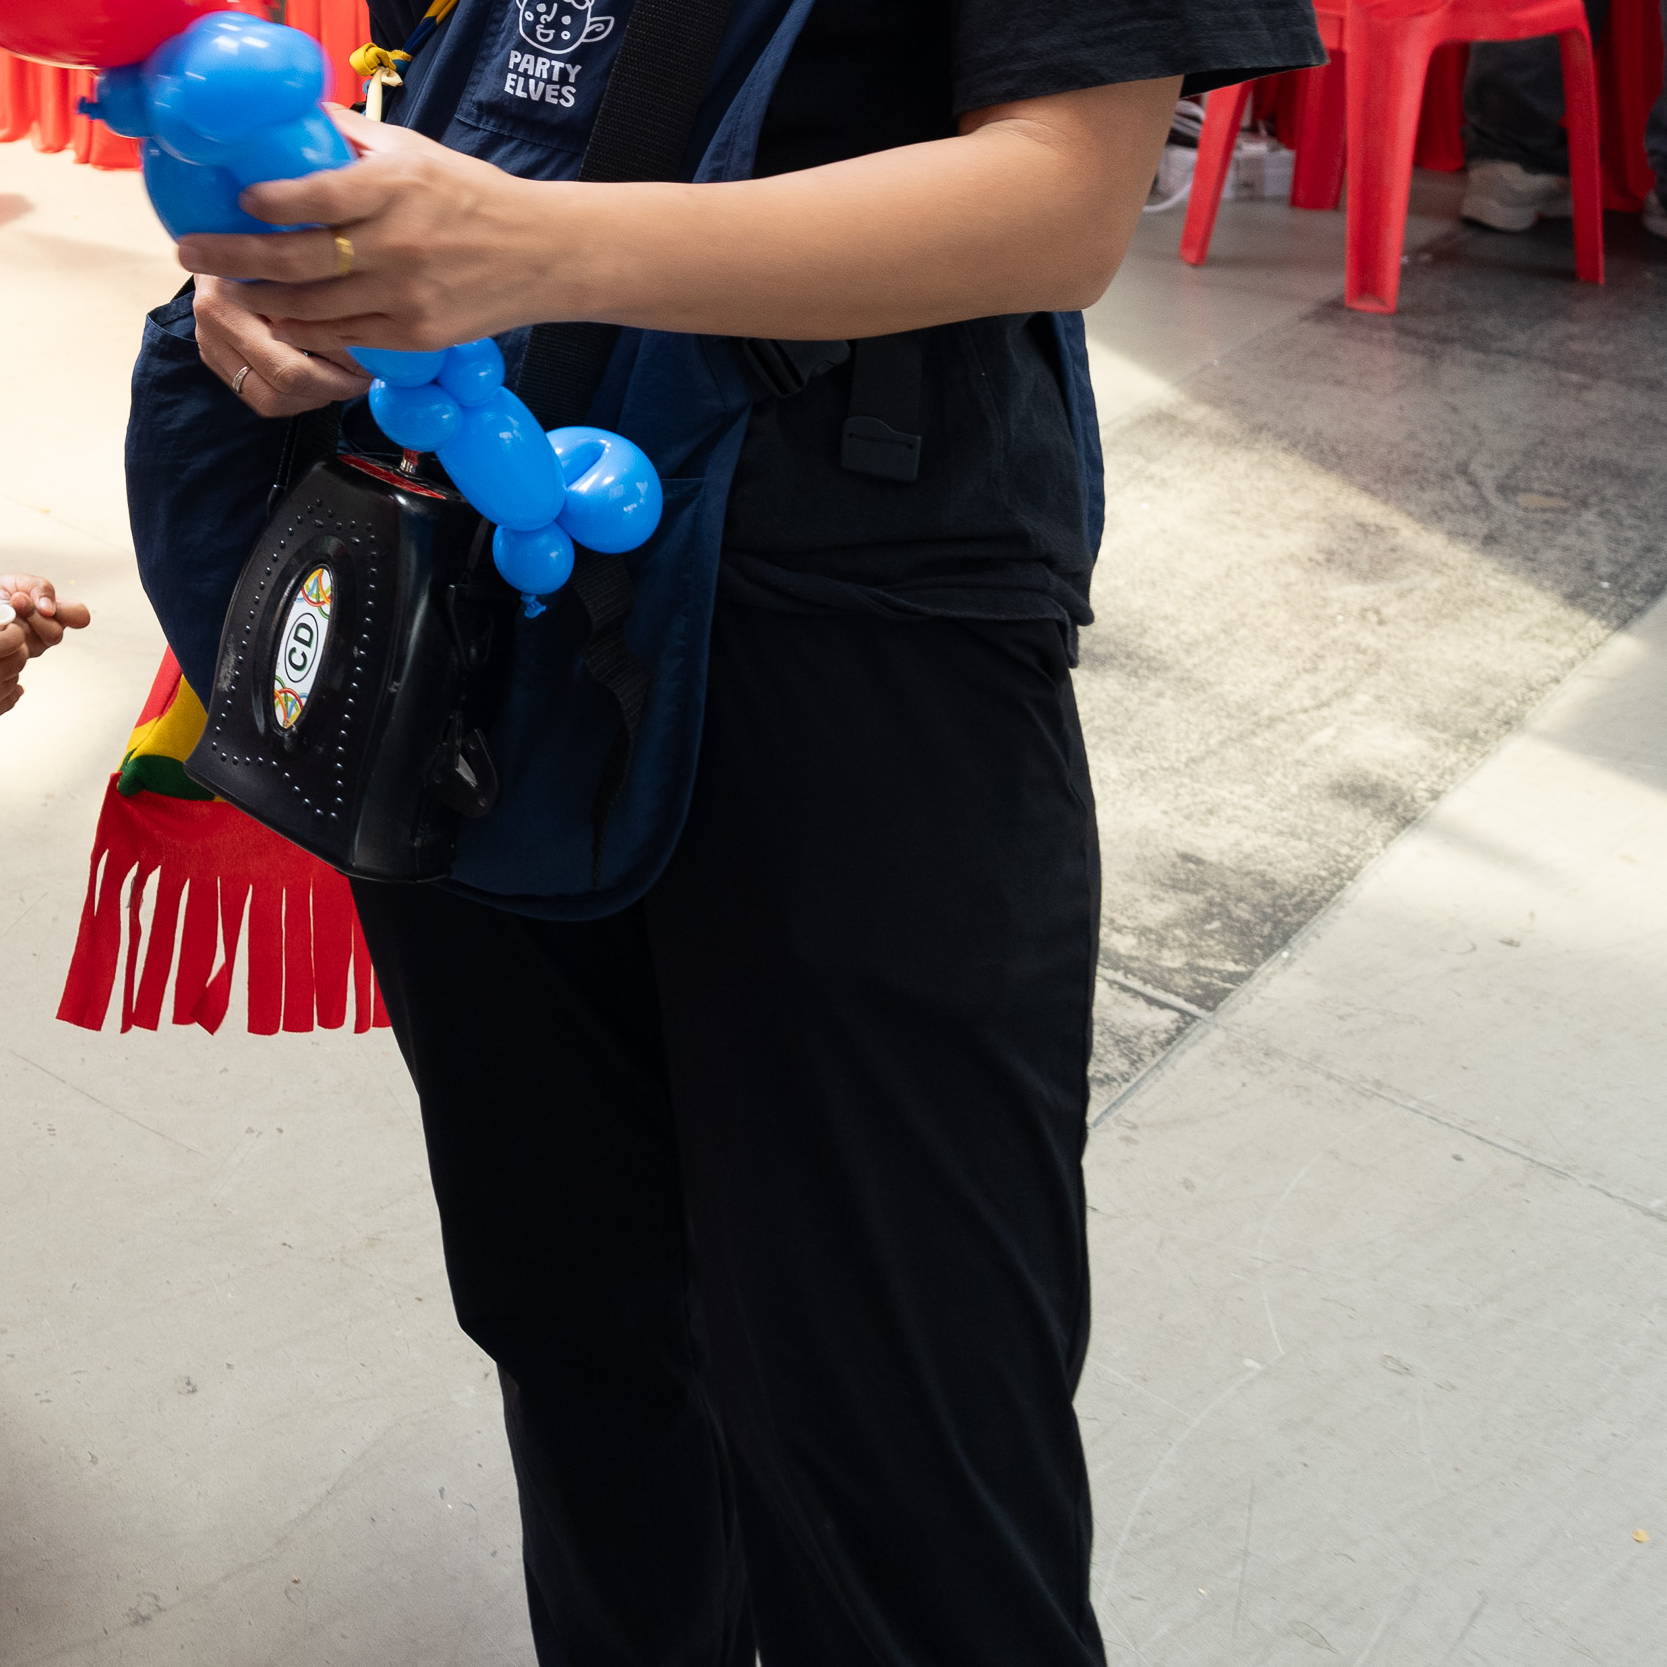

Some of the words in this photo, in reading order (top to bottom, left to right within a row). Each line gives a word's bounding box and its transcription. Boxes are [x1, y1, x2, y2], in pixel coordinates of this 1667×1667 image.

[508, 50, 582, 83] PARTY
[504, 72, 577, 108] ELVES
[288, 622, 315, 672] CD
